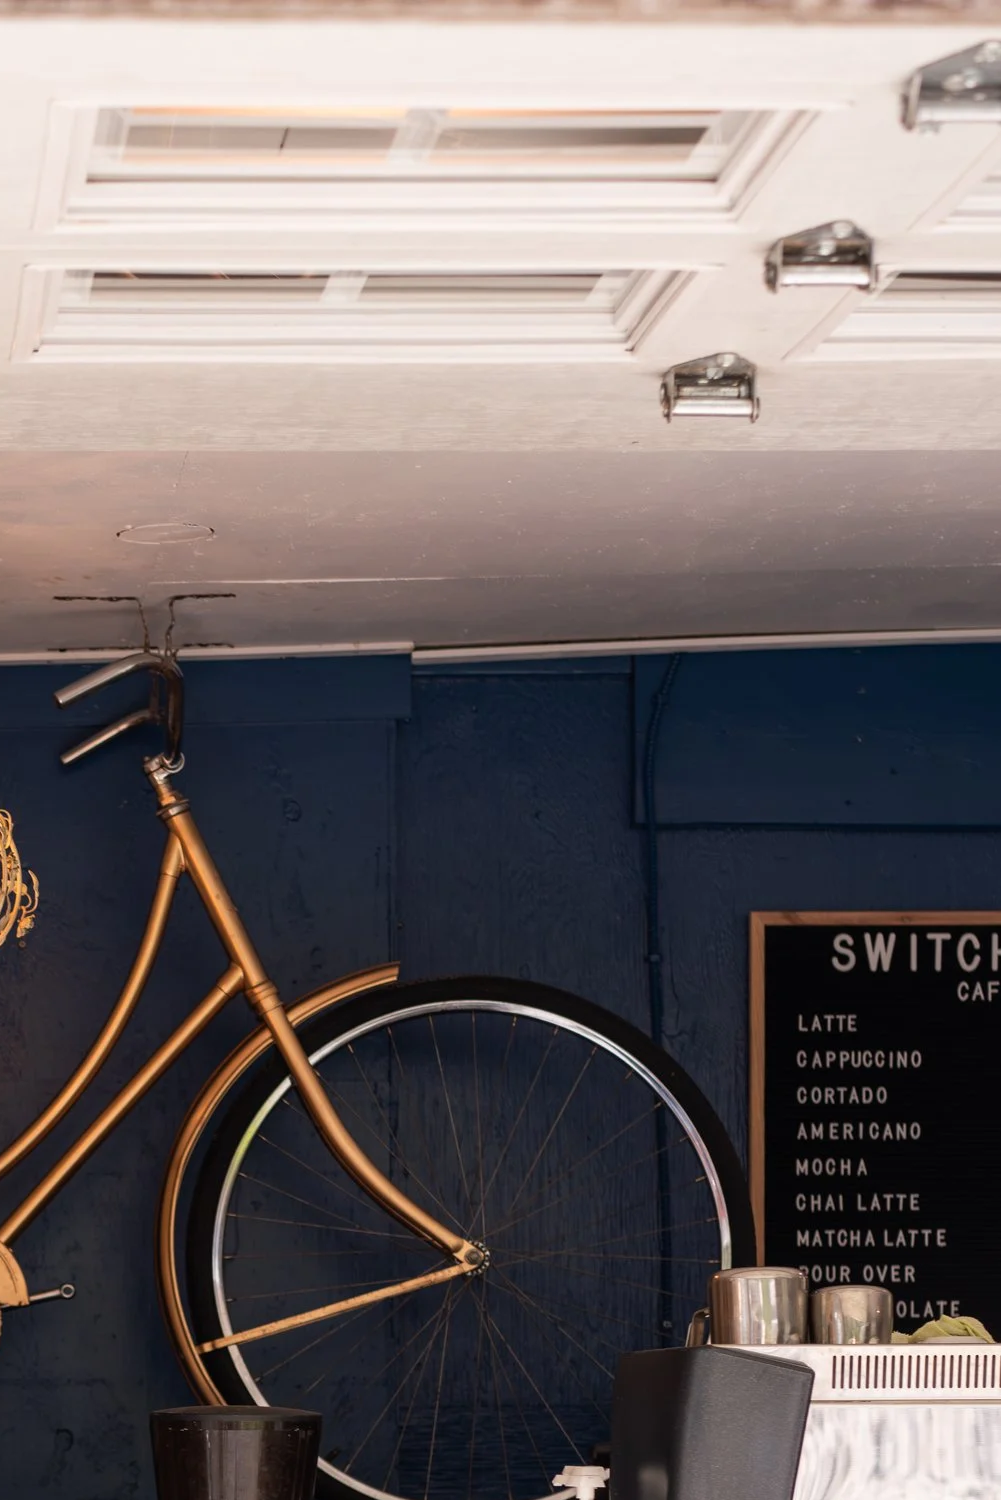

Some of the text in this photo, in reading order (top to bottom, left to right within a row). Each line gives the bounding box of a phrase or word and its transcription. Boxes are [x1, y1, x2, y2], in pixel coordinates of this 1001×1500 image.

[799, 1015, 856, 1031] LATTE
[797, 1051, 921, 1068] CAPPUCCINO
[797, 1087, 887, 1103] CORTADO
[798, 1123, 920, 1140] AMERICANO
[797, 1159, 867, 1175] MOCHA
[796, 1194, 919, 1211] CHAI LATTE
[797, 1229, 946, 1247] MATCHA LATTE
[863, 1265, 914, 1282] OVER
